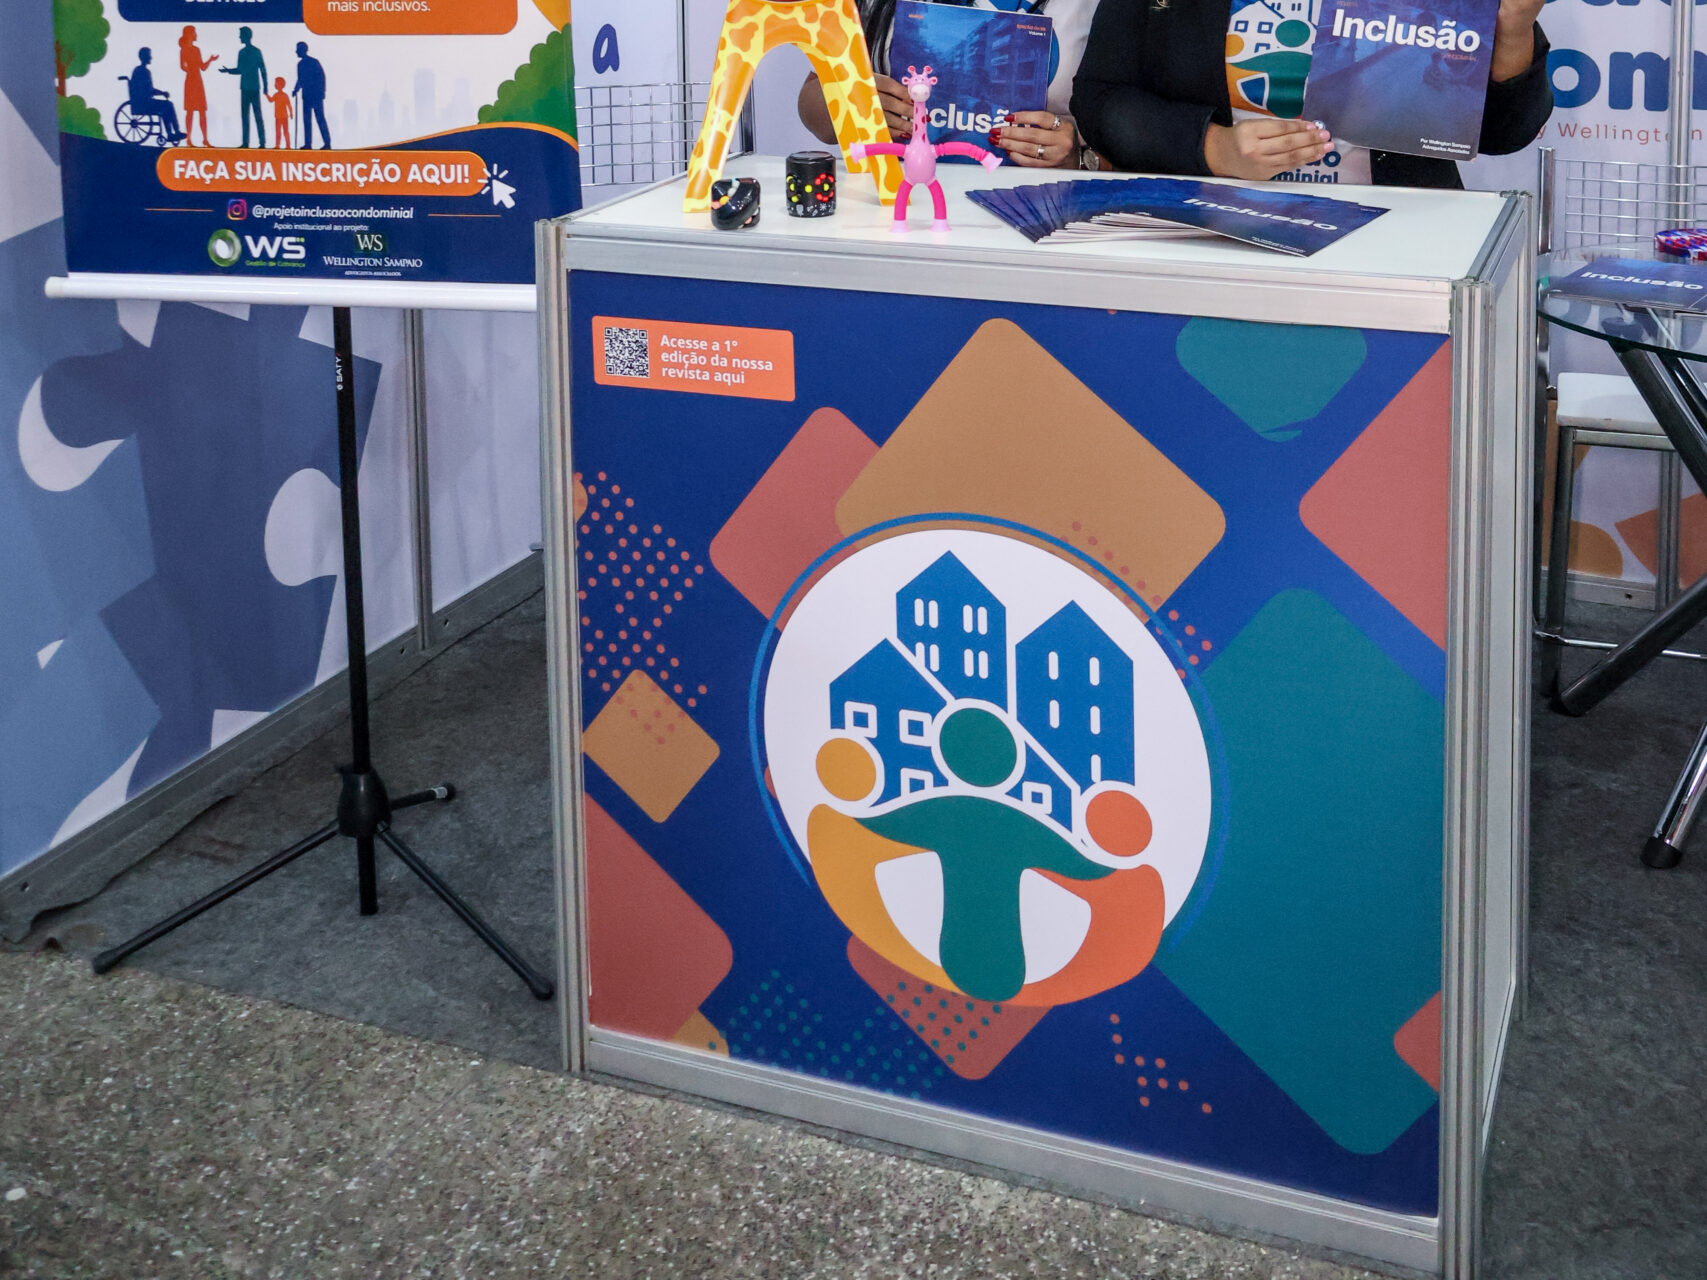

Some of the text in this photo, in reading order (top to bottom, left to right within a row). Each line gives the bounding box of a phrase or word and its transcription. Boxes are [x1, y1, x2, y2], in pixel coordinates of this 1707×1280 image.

[1332, 8, 1480, 52] Inclusão
[173, 158, 470, 187] FAÇA SUA INSCRIÇÃO AQUI!
[252, 204, 413, 219] @projetoinclusaocondominial
[244, 235, 306, 259] WS
[355, 234, 383, 252] WS
[660, 335, 708, 350] Acesse
[711, 341, 720, 351] a
[661, 351, 773, 371] edição da nossa
[662, 366, 745, 386] revista aqui
